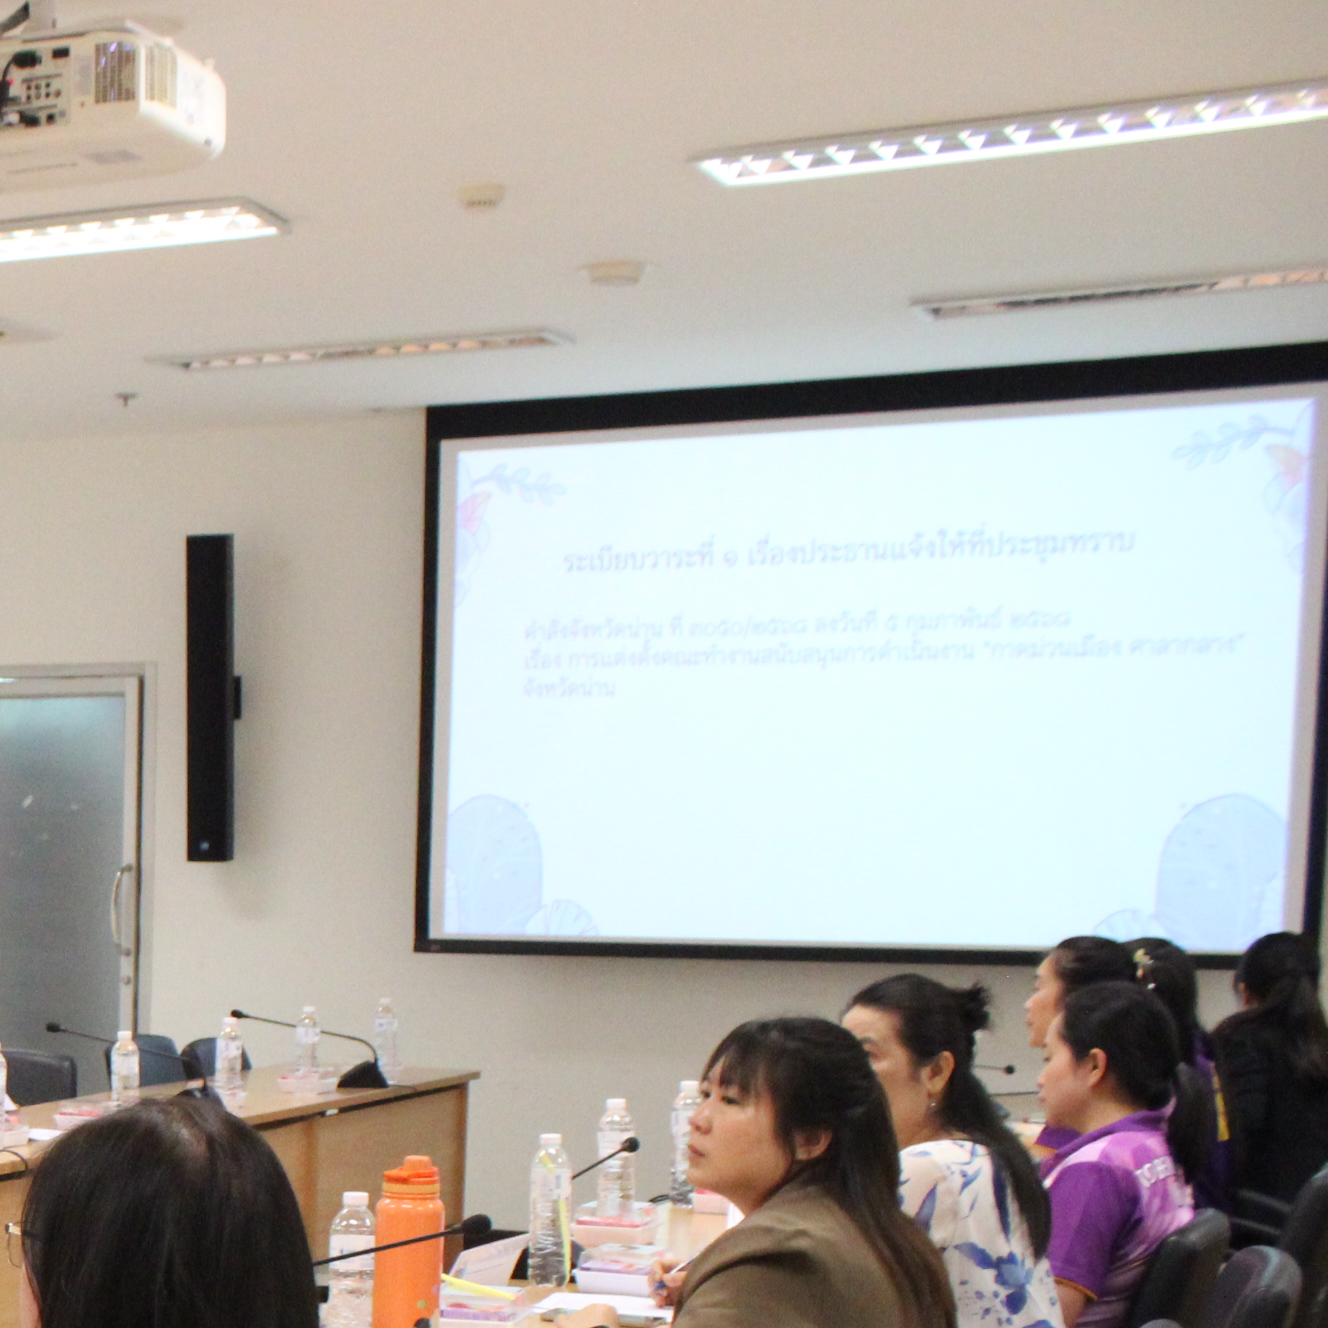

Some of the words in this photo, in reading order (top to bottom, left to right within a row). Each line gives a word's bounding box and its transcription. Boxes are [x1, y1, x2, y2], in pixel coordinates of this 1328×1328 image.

[563, 533, 716, 574] ระเบียบวาระที่
[722, 547, 739, 569] ๑
[748, 522, 1136, 567] เรื่องประธานแจ้งให้ที่ประชุมทราบ
[670, 609, 684, 637] ที่
[815, 603, 879, 633] ลงวันที่
[524, 643, 562, 671] เรื่อง
[523, 674, 617, 699] จังหวัดน่าน
